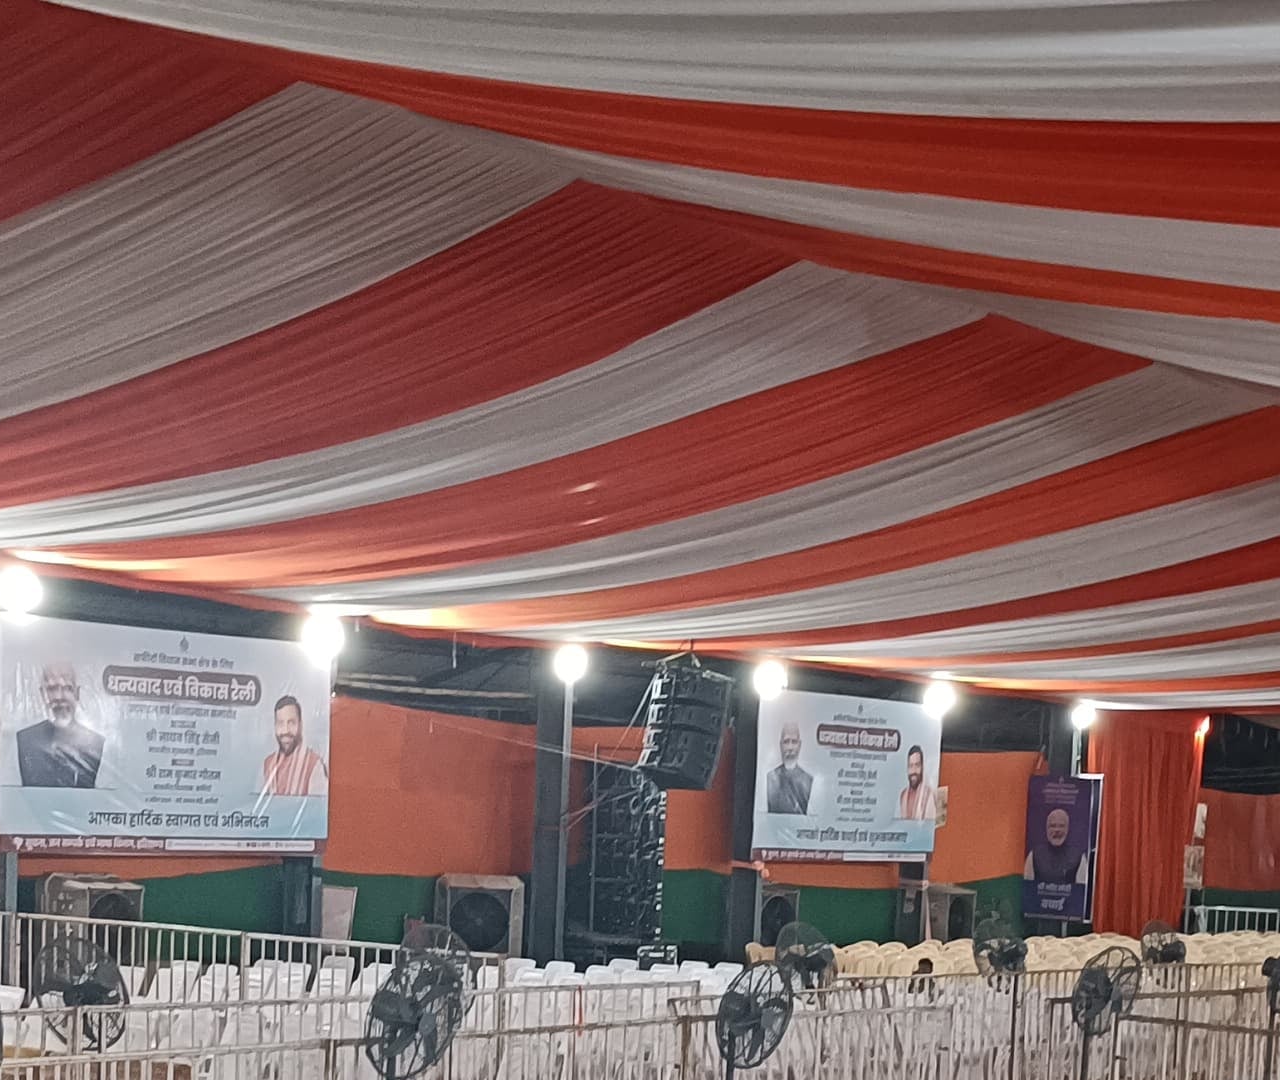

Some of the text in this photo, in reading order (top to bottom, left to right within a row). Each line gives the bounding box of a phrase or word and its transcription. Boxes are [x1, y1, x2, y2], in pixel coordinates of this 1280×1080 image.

[108, 674, 256, 702] धन्यवाद एवं विकास रैली
[88, 811, 127, 826] आपका
[129, 809, 163, 828] हार्दिक
[165, 814, 201, 828] स्वागत
[203, 812, 218, 827] एवं
